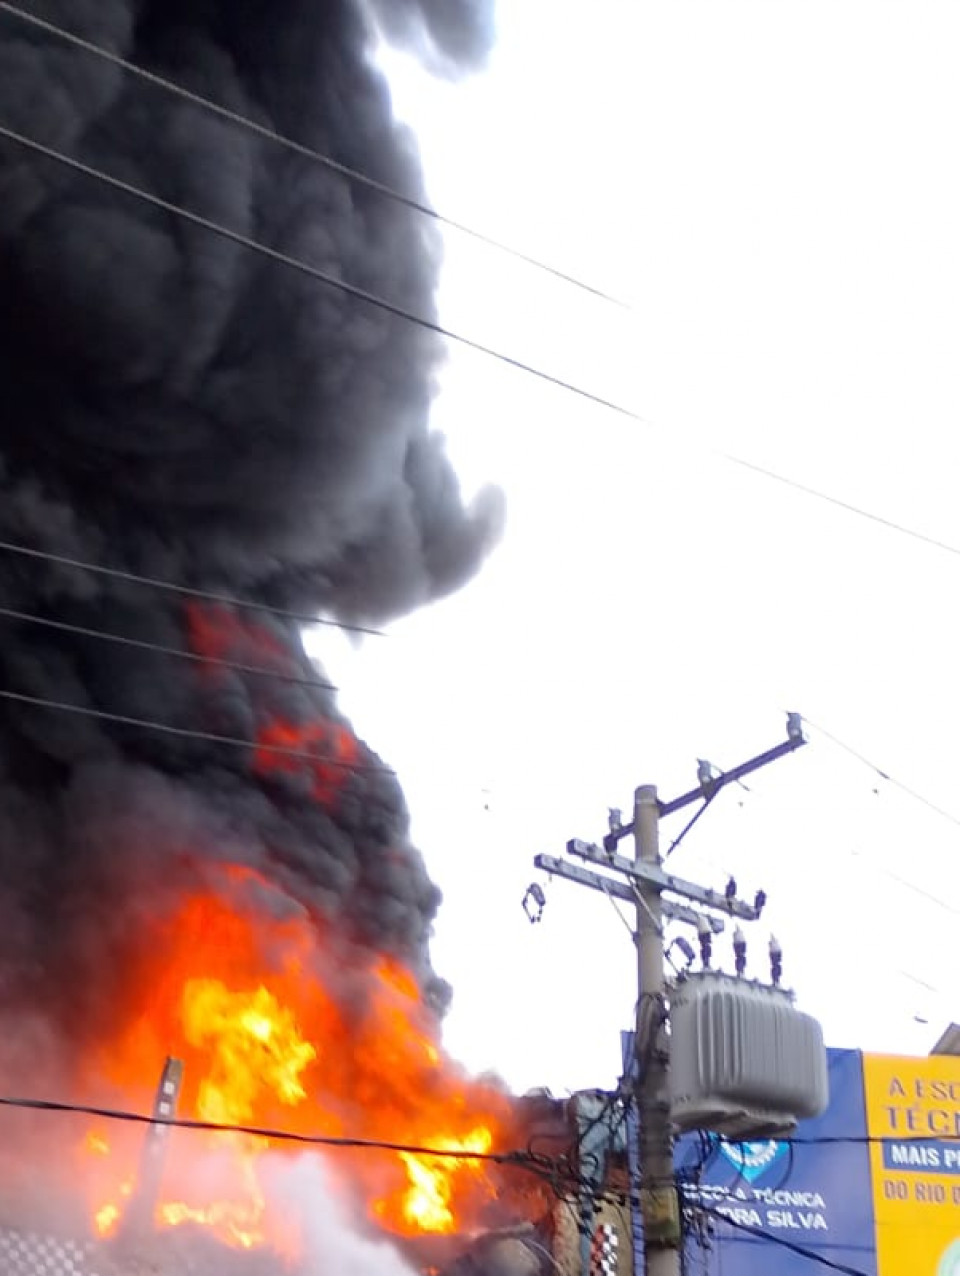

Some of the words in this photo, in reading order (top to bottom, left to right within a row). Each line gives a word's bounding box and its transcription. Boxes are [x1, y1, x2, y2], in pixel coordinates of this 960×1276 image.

[891, 1144, 940, 1167] MAIS
[752, 1186, 826, 1209] TÉCNICA
[884, 1179, 908, 1200] DO
[915, 1182, 945, 1203] RIO
[767, 1210, 828, 1230] SILVA
